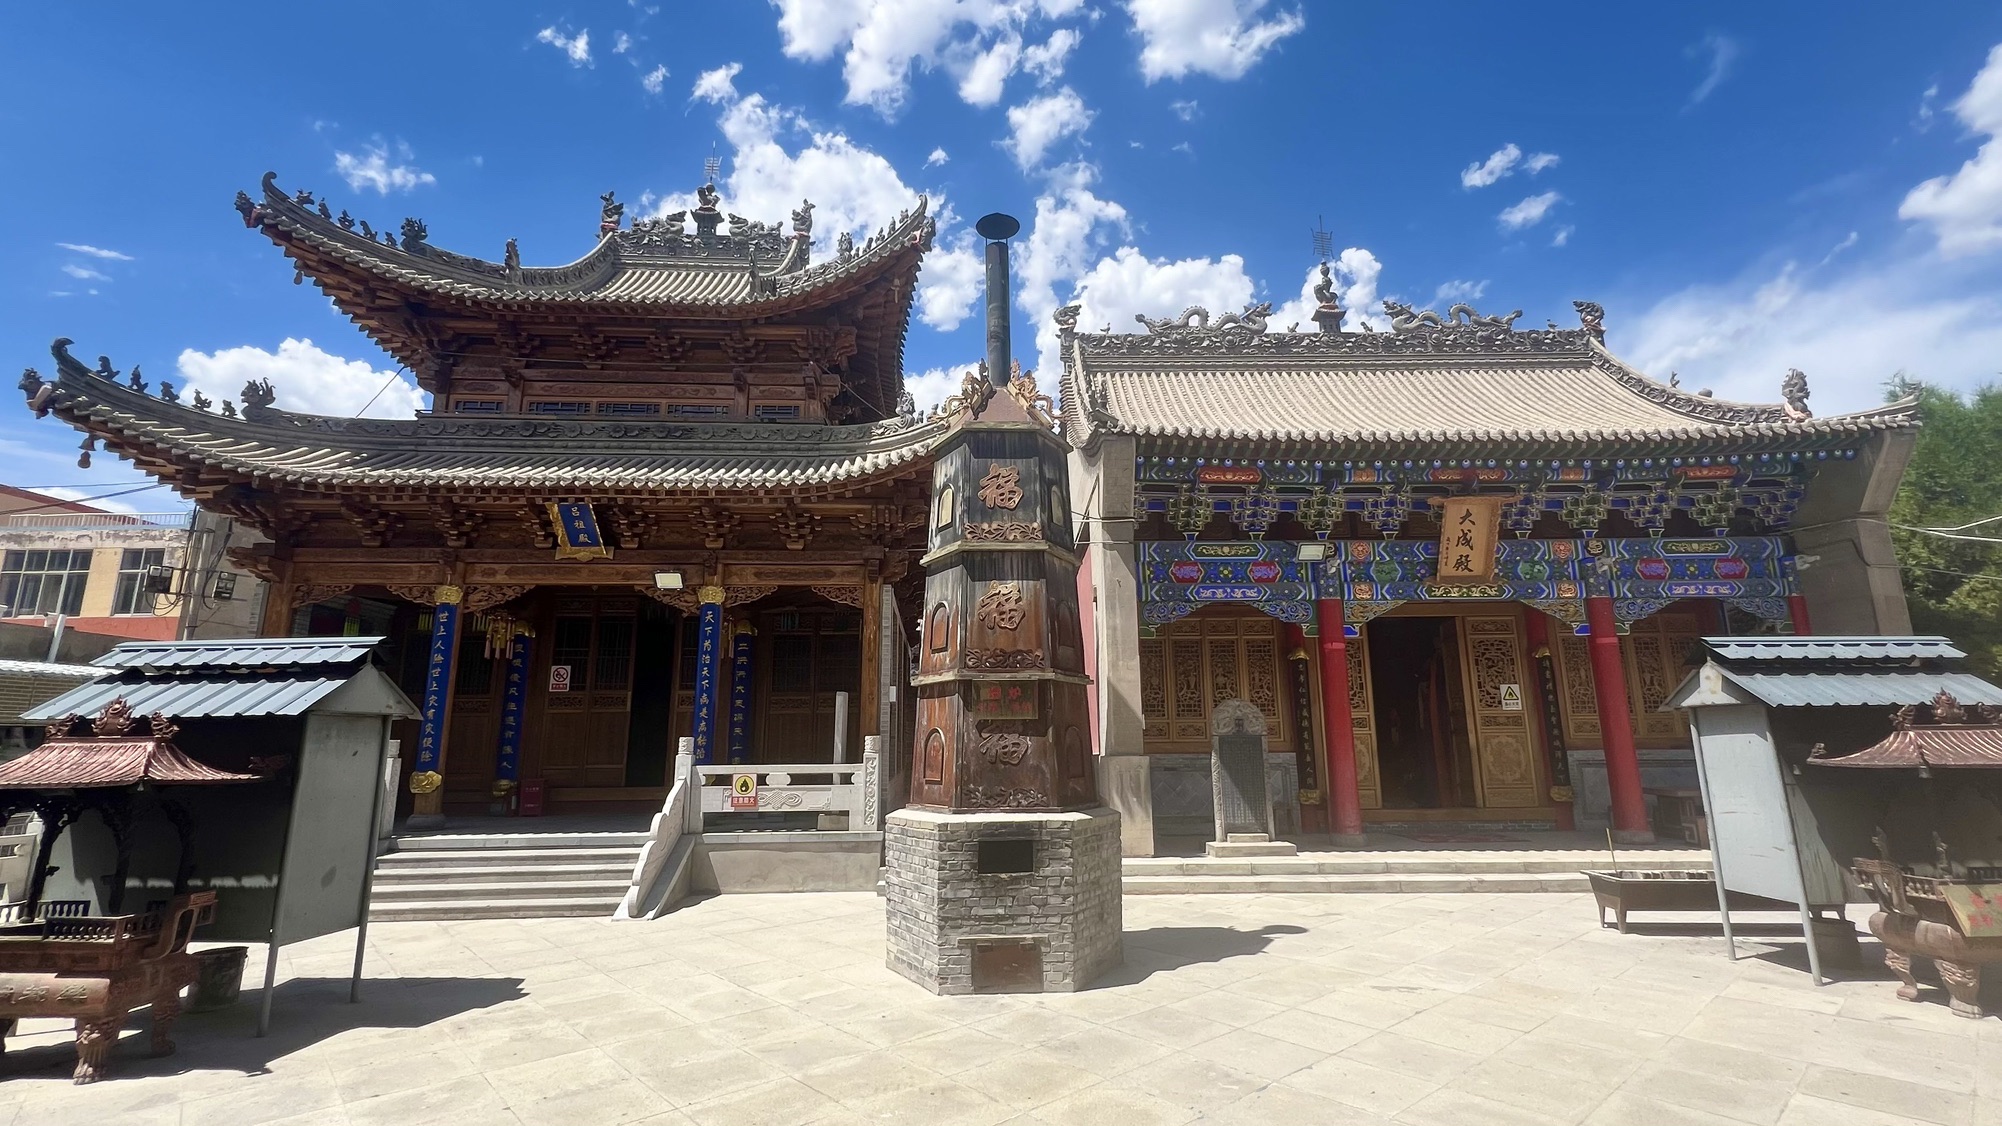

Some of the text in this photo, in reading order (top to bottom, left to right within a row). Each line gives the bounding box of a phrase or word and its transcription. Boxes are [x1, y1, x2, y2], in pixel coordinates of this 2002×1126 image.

[977, 463, 1024, 510] 福
[1452, 508, 1476, 573] 大成殿
[977, 580, 1026, 630] 福
